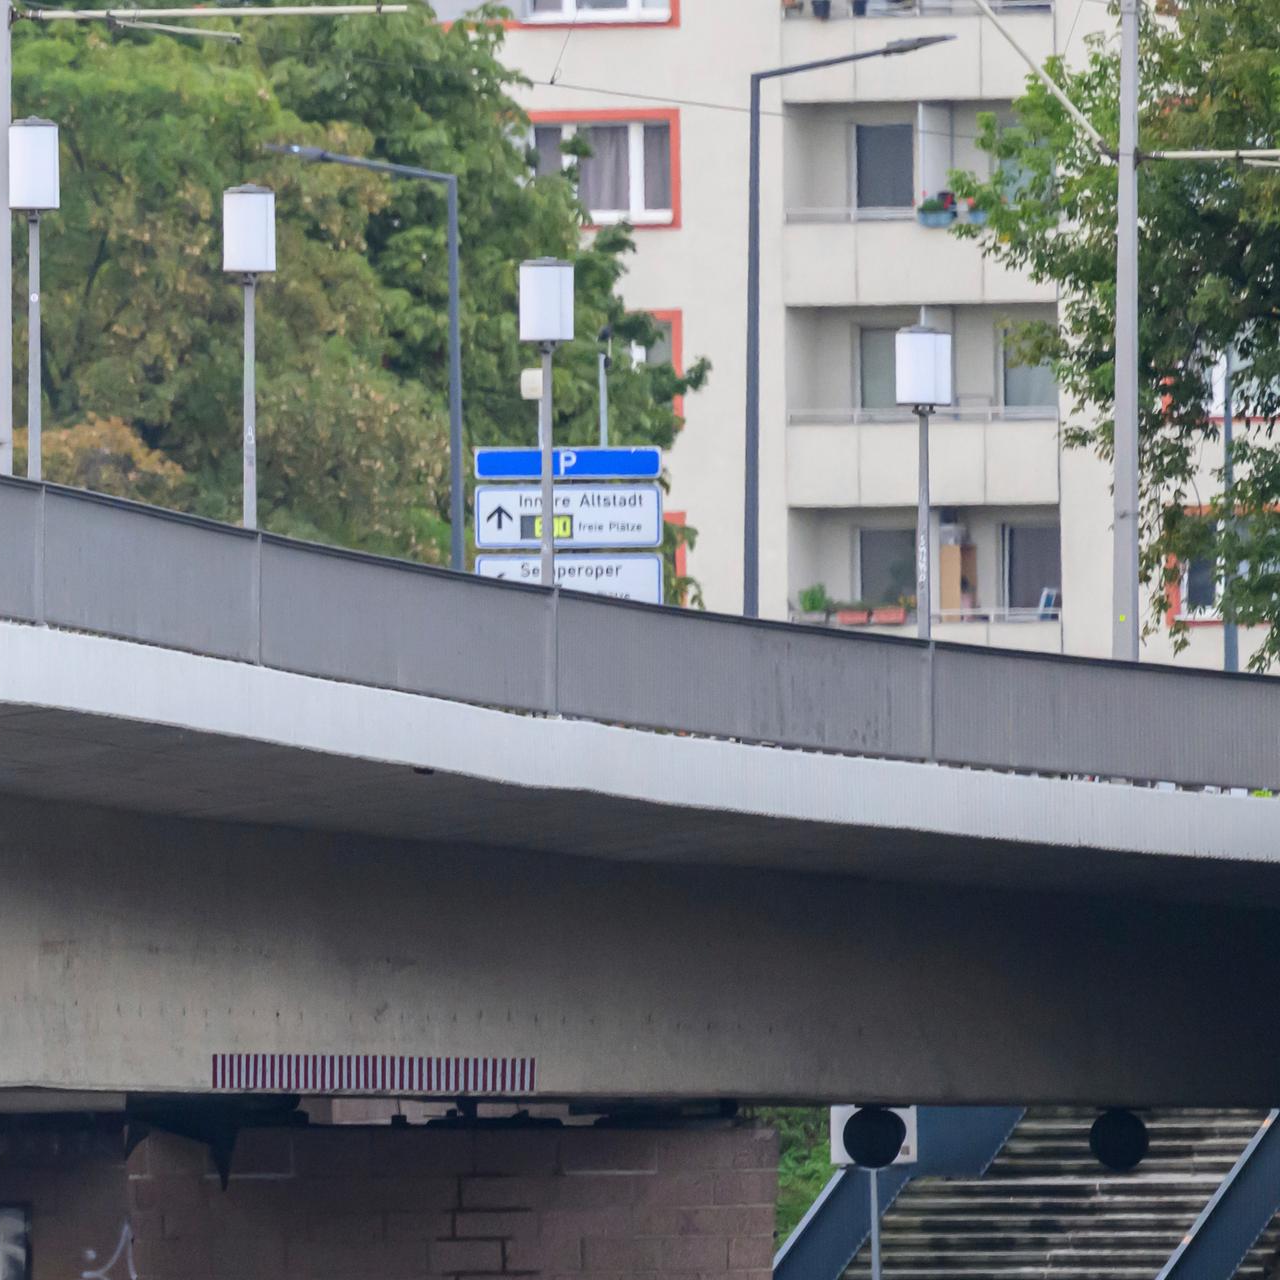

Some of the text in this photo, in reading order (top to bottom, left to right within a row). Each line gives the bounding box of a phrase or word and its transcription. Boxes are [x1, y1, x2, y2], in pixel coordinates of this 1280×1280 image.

[559, 450, 577, 476] P
[519, 493, 643, 508] Innre Altstadt
[579, 521, 642, 532] freie Plätze
[521, 562, 623, 580] Seperoper
